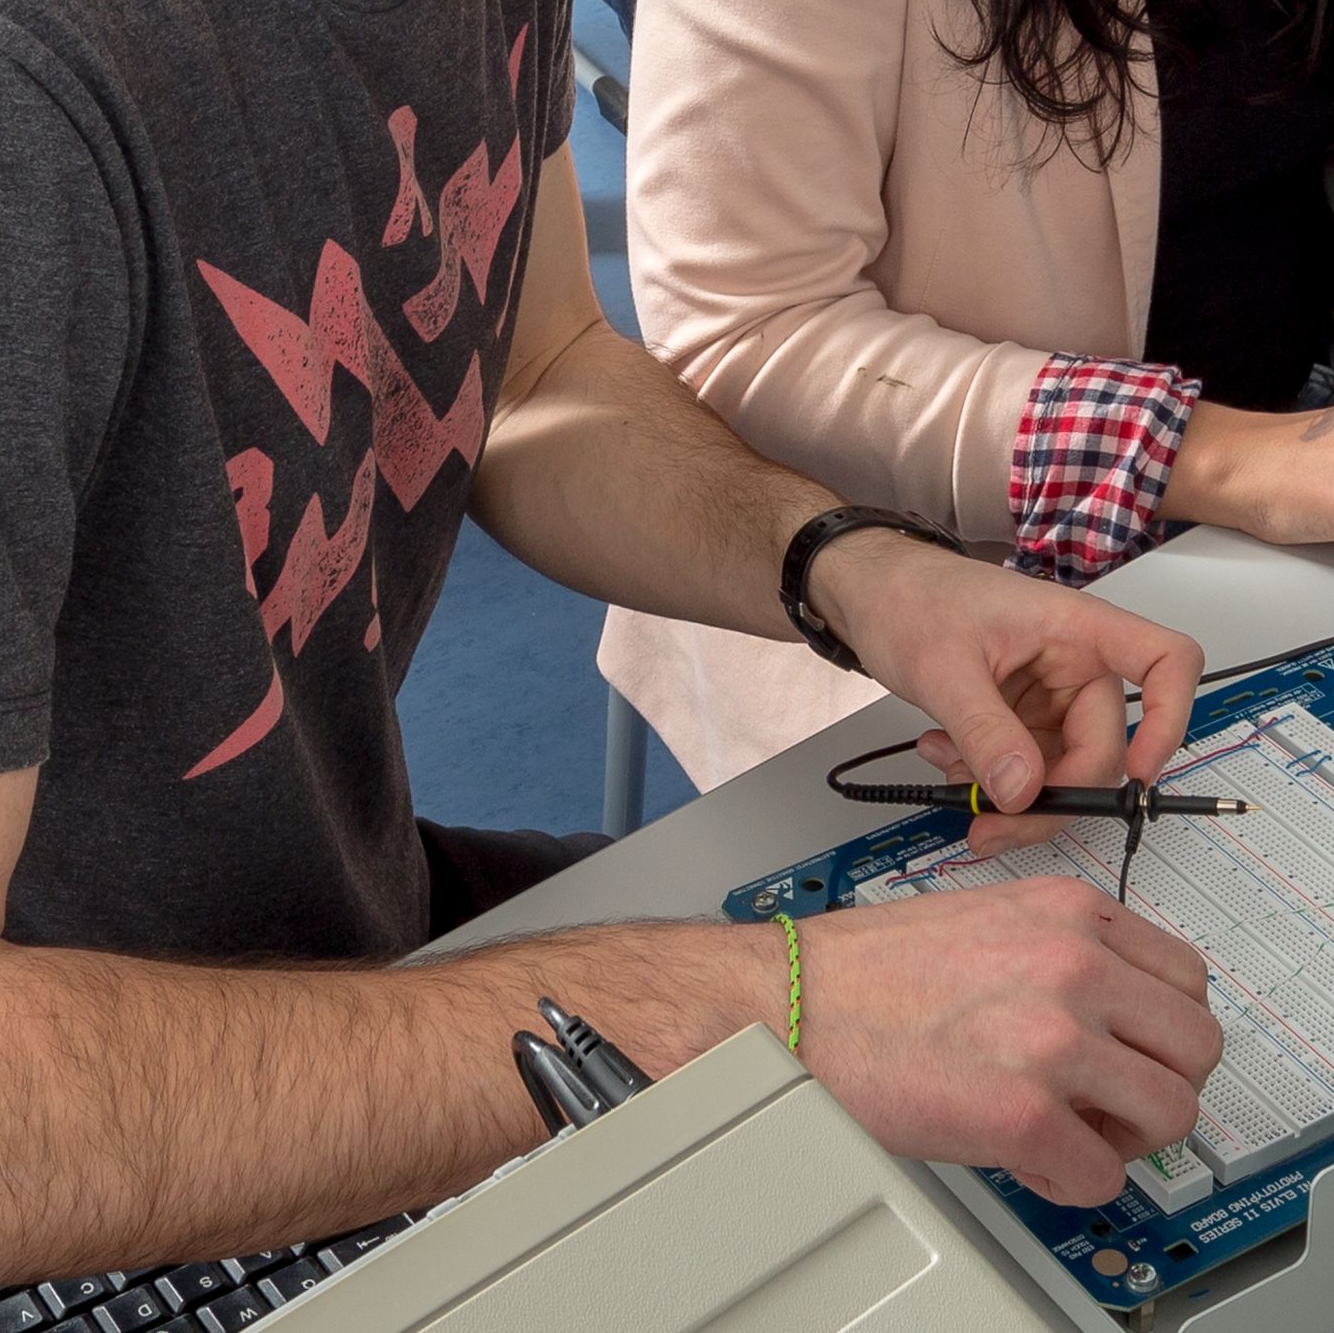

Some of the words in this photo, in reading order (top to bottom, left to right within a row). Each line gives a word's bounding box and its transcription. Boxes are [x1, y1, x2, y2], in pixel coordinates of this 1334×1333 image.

[1228, 1171, 1304, 1213] PROTOTYPING
[1260, 1190, 1298, 1212] ELVIS
[1190, 1209, 1229, 1232] BOARD
[1243, 1209, 1260, 1221] II
[1199, 1217, 1243, 1244] SERIES
[80, 1282, 95, 1294] C
[199, 1276, 213, 1288] S
[20, 1311, 34, 1323] V
[137, 1303, 152, 1317] D
[239, 1307, 258, 1322] W
